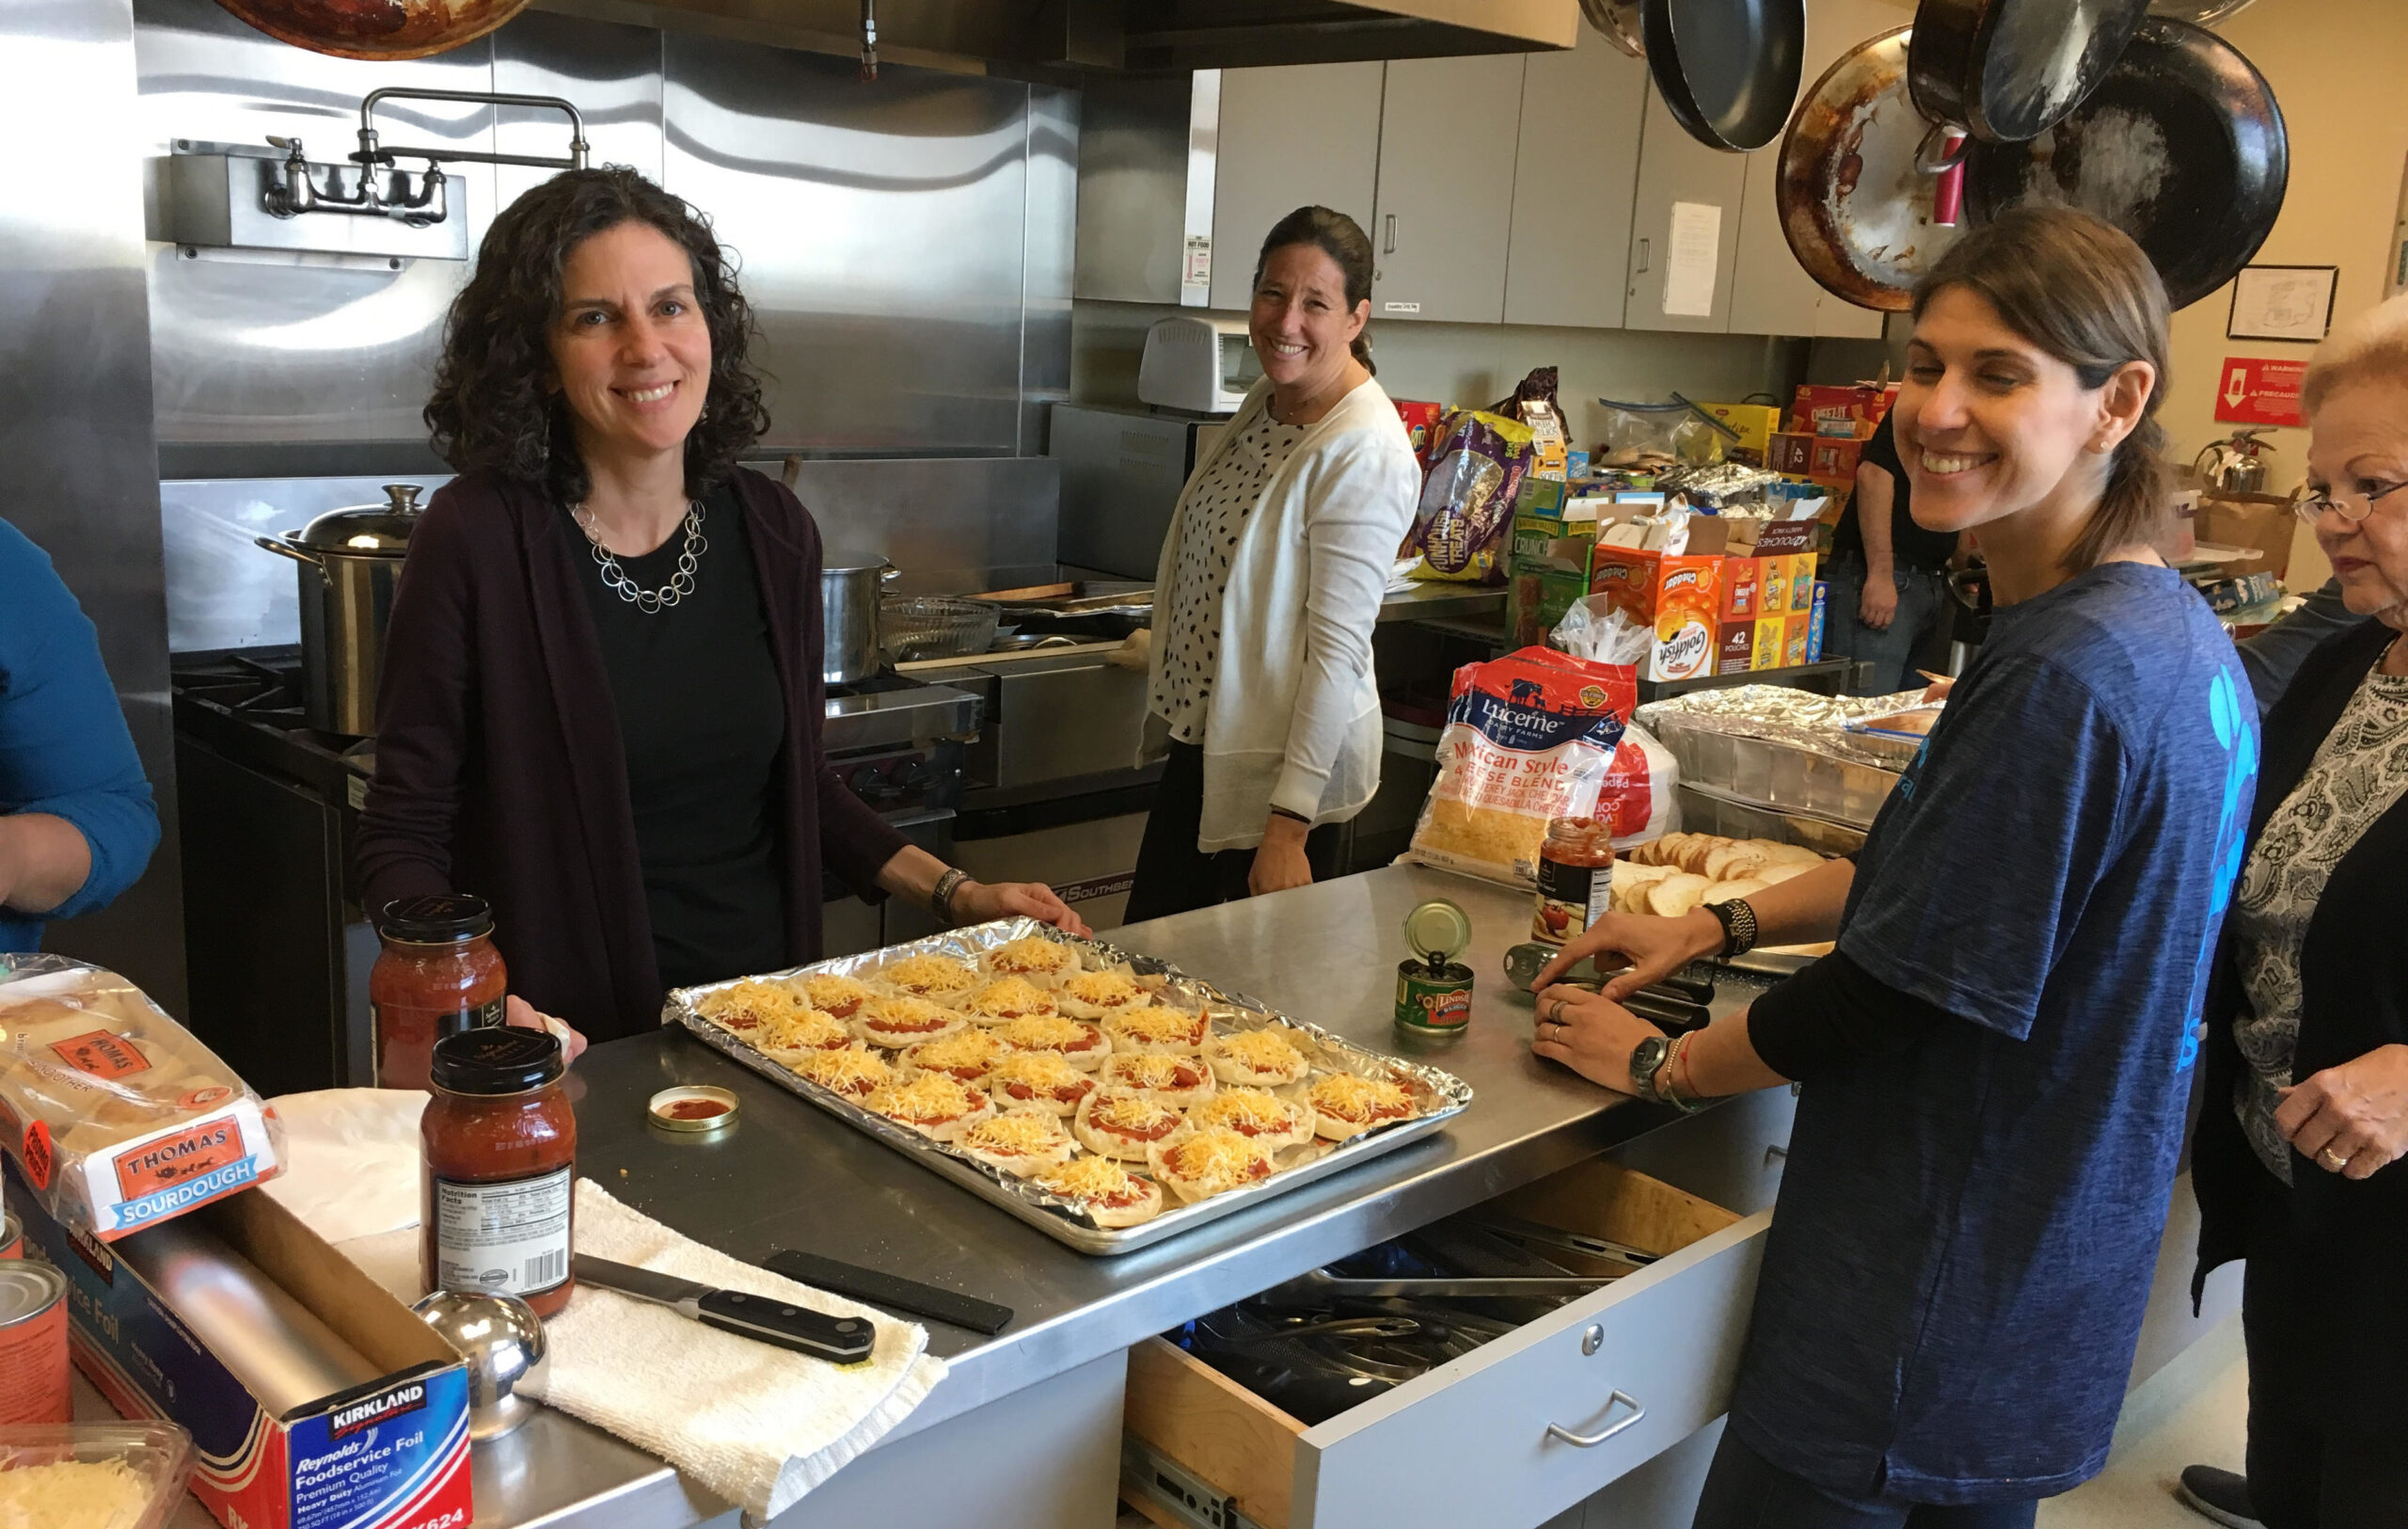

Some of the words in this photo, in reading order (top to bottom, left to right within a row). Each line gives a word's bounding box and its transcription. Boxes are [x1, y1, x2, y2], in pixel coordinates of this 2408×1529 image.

[1793, 447, 1803, 464] 42
[1427, 509, 1451, 571] FUNHOUSE
[1450, 518, 1465, 565] TREATS
[1757, 536, 1796, 548] POUCHES
[1595, 566, 1627, 581] Cheddar
[1664, 572, 1697, 591] Cheddar
[1659, 631, 1705, 665] Goldfish
[1732, 631, 1746, 644] 42
[1482, 698, 1559, 733] Lucerne
[1516, 728, 1544, 740] FARMS
[1512, 776, 1565, 791] BLEND
[1523, 757, 1568, 781] Style
[127, 1130, 227, 1175] THOMAS
[122, 1163, 252, 1222] SOURDOUGH
[441, 1187, 478, 1199] Nutrition
[441, 1195, 462, 1204] Facts
[95, 1298, 119, 1344] Foil
[333, 1386, 423, 1429] KIRKLAND
[295, 1441, 360, 1474] Reynolds
[295, 1446, 391, 1489] Foodservice
[396, 1430, 423, 1452] Foil
[296, 1480, 346, 1505] Premium
[349, 1462, 388, 1483] Quality
[297, 1499, 327, 1514] Heavy
[329, 1489, 353, 1502] Duty
[354, 1476, 388, 1492] Aluminum
[389, 1468, 402, 1478] Foil
